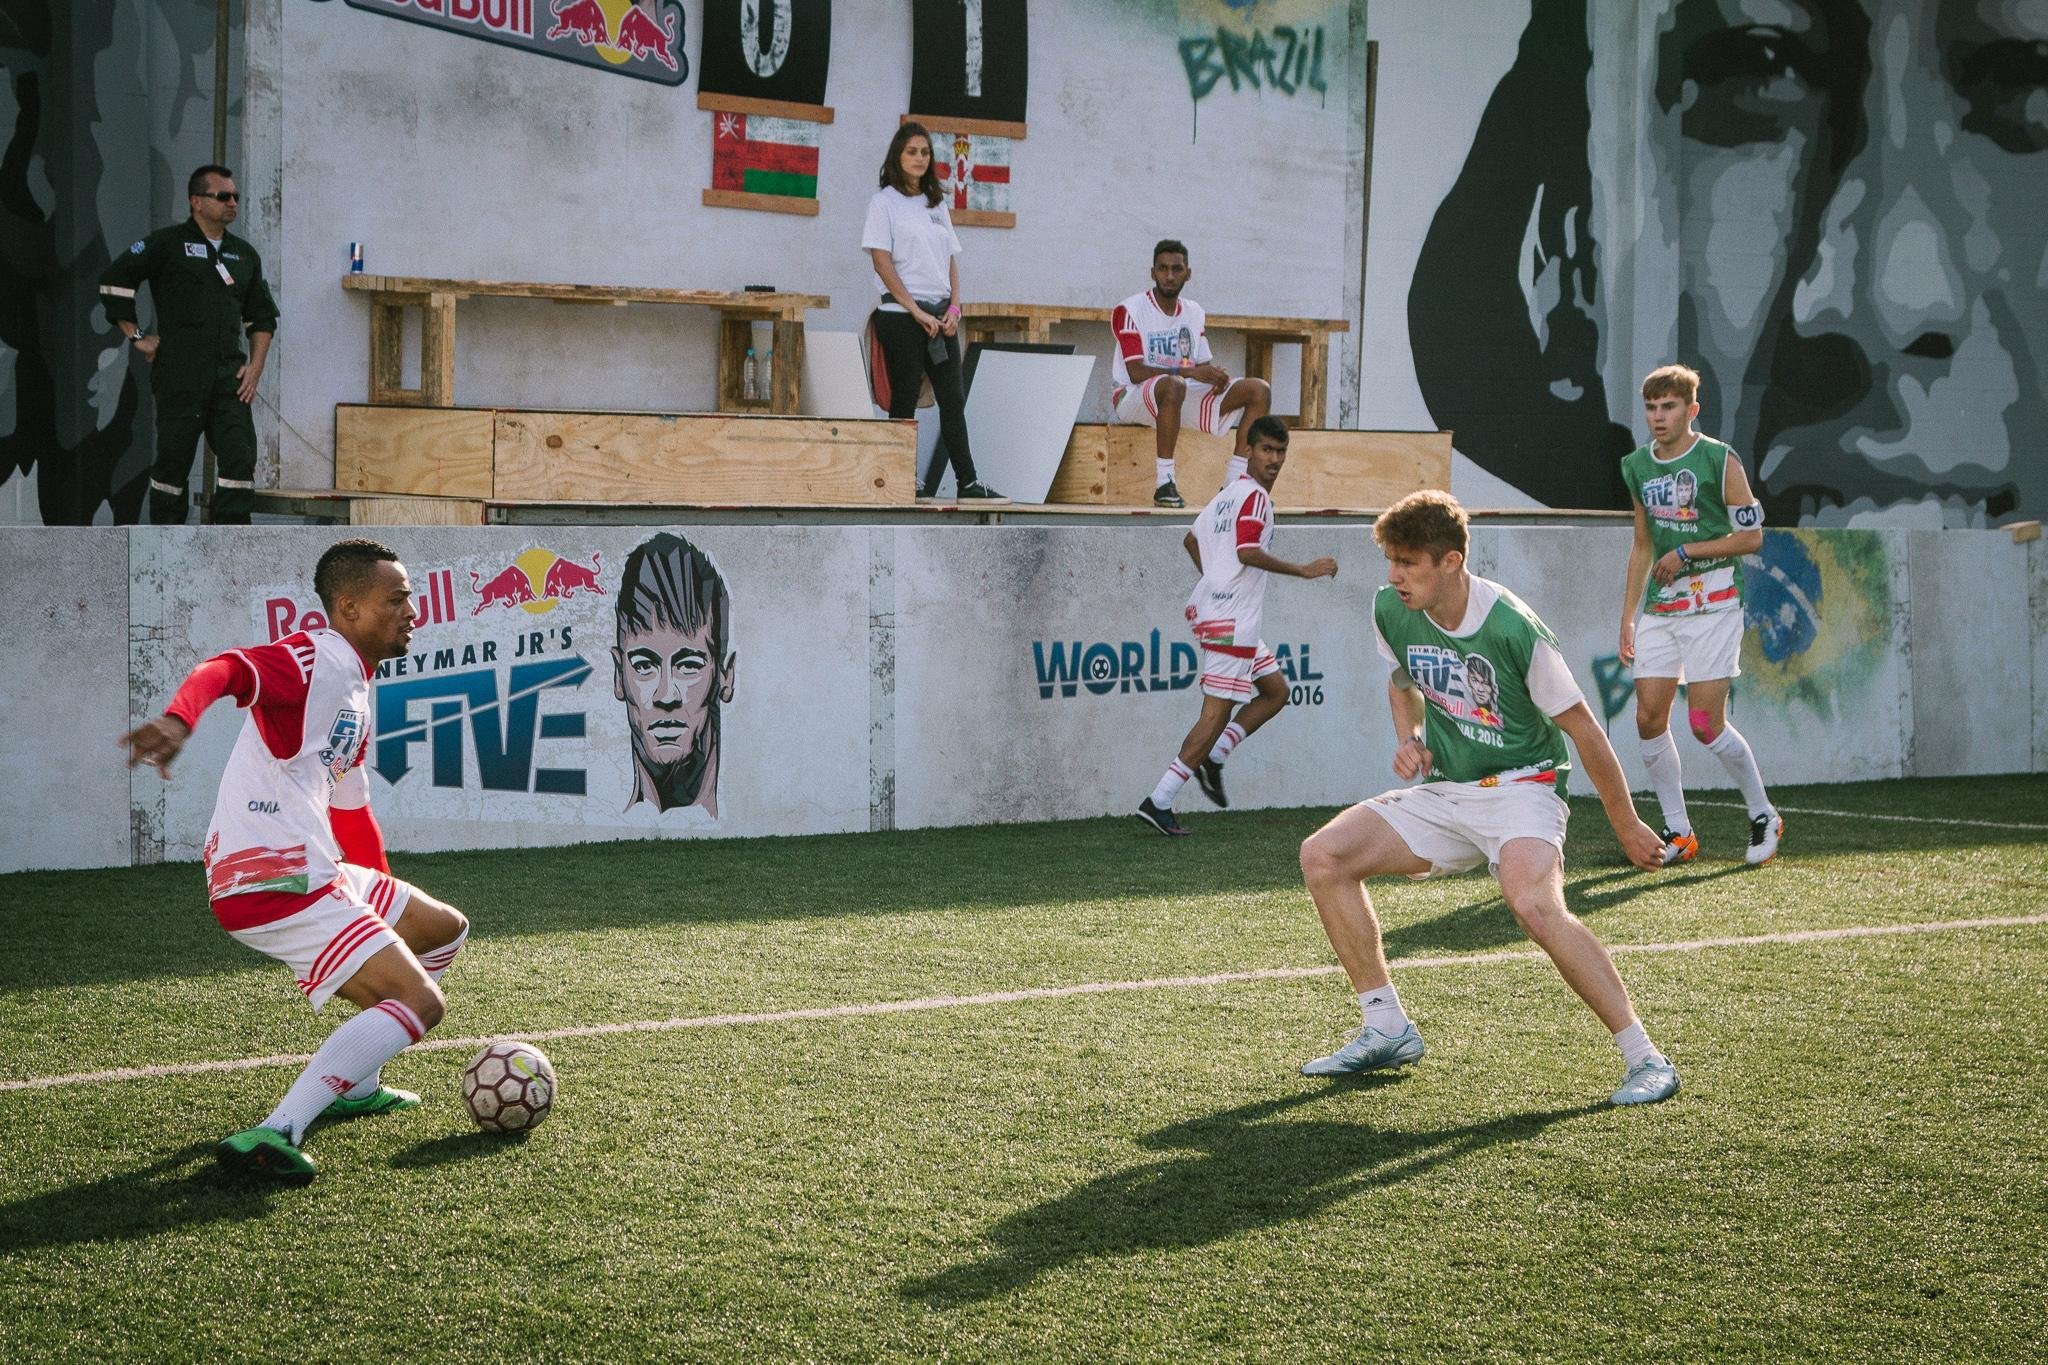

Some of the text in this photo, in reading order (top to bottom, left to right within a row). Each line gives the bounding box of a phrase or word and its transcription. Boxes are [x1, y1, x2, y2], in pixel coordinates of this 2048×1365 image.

[1681, 523, 1698, 533] 2016
[1738, 509, 1755, 524] 04
[265, 570, 456, 645] Re ull
[375, 626, 574, 680] NEYMAR JR'S
[1032, 626, 1199, 700] WORLD
[1285, 684, 1324, 706] 016
[372, 652, 594, 796] FIVE
[1477, 728, 1504, 750] 2016
